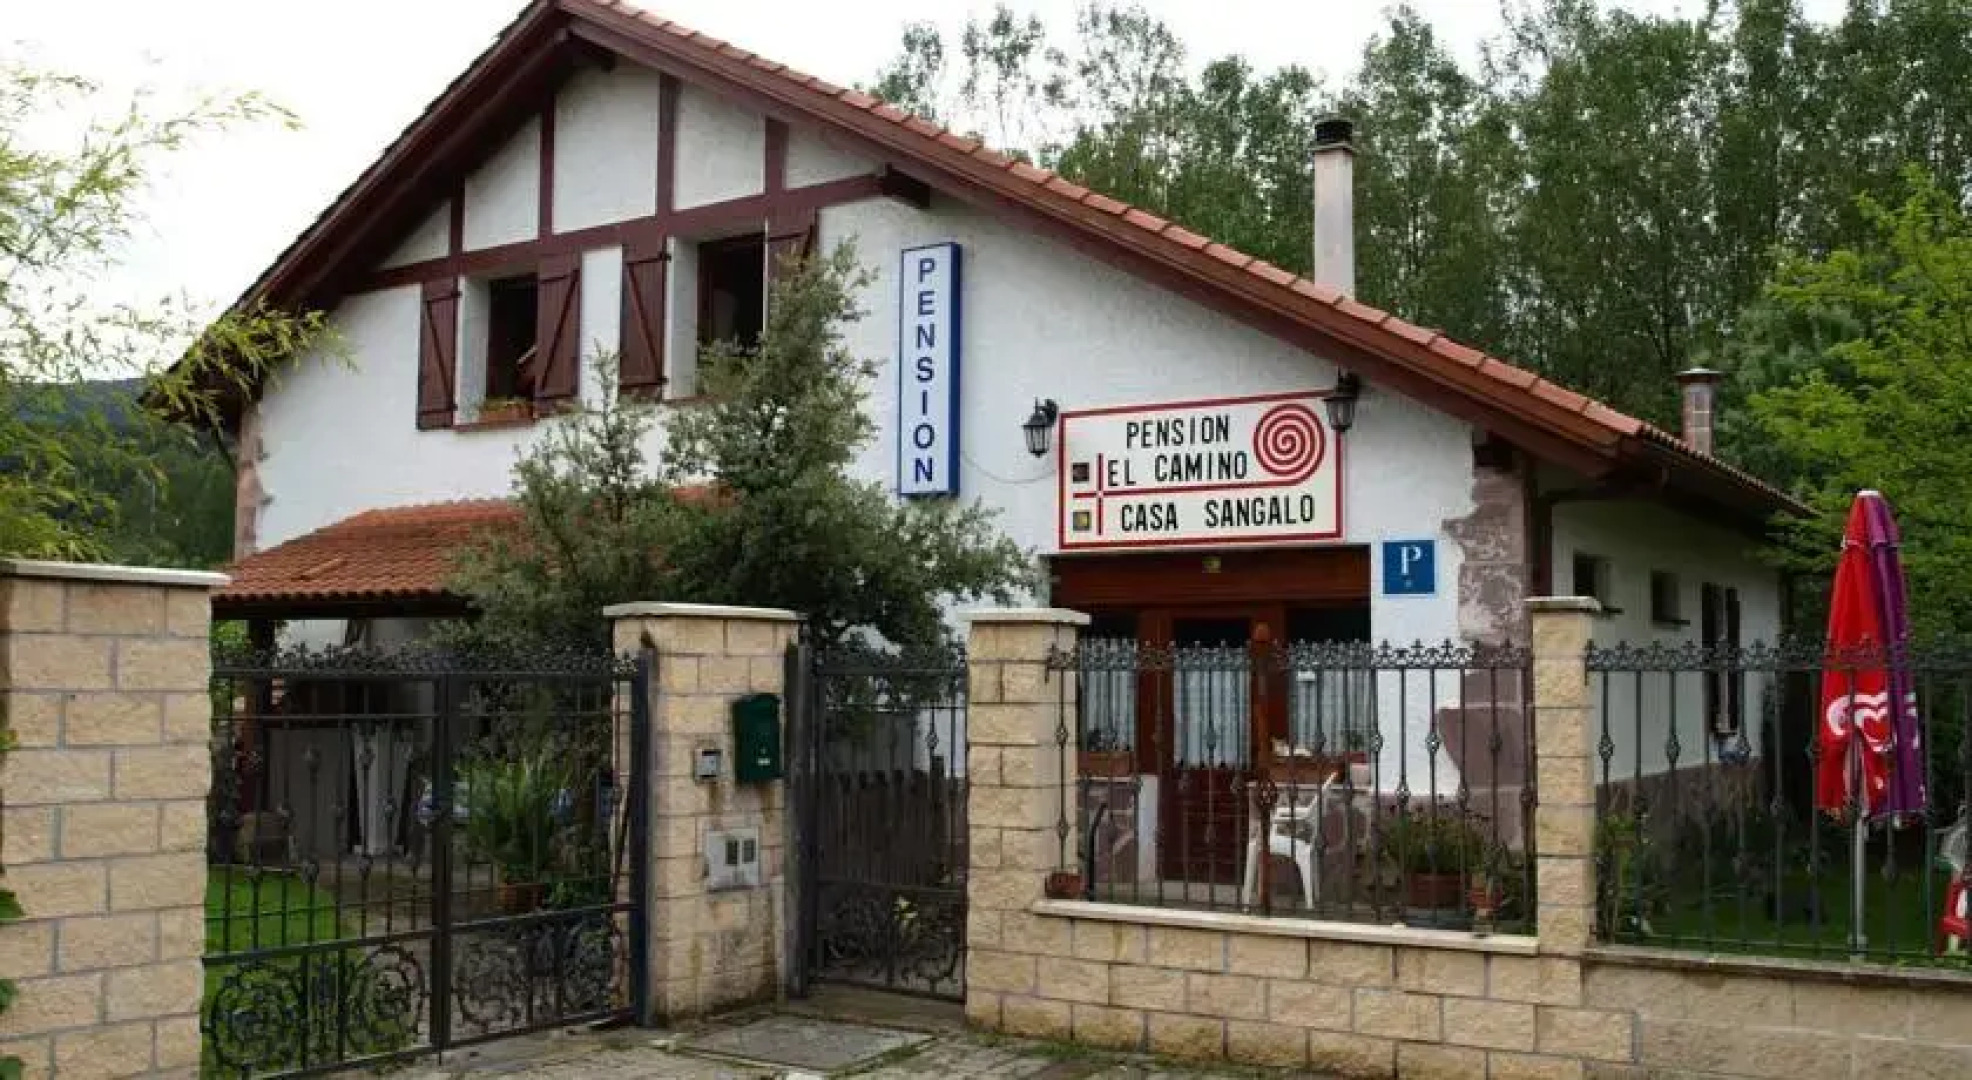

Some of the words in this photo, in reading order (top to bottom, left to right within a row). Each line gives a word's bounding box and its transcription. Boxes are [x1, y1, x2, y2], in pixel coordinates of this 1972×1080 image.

[913, 257, 935, 484] PENSION
[1126, 415, 1230, 448] PENSION
[1108, 459, 1136, 487] EL
[1154, 451, 1248, 482] CAMINO
[1121, 503, 1179, 532] CASA
[1205, 495, 1315, 529] SANGALO
[1400, 545, 1421, 575] P
